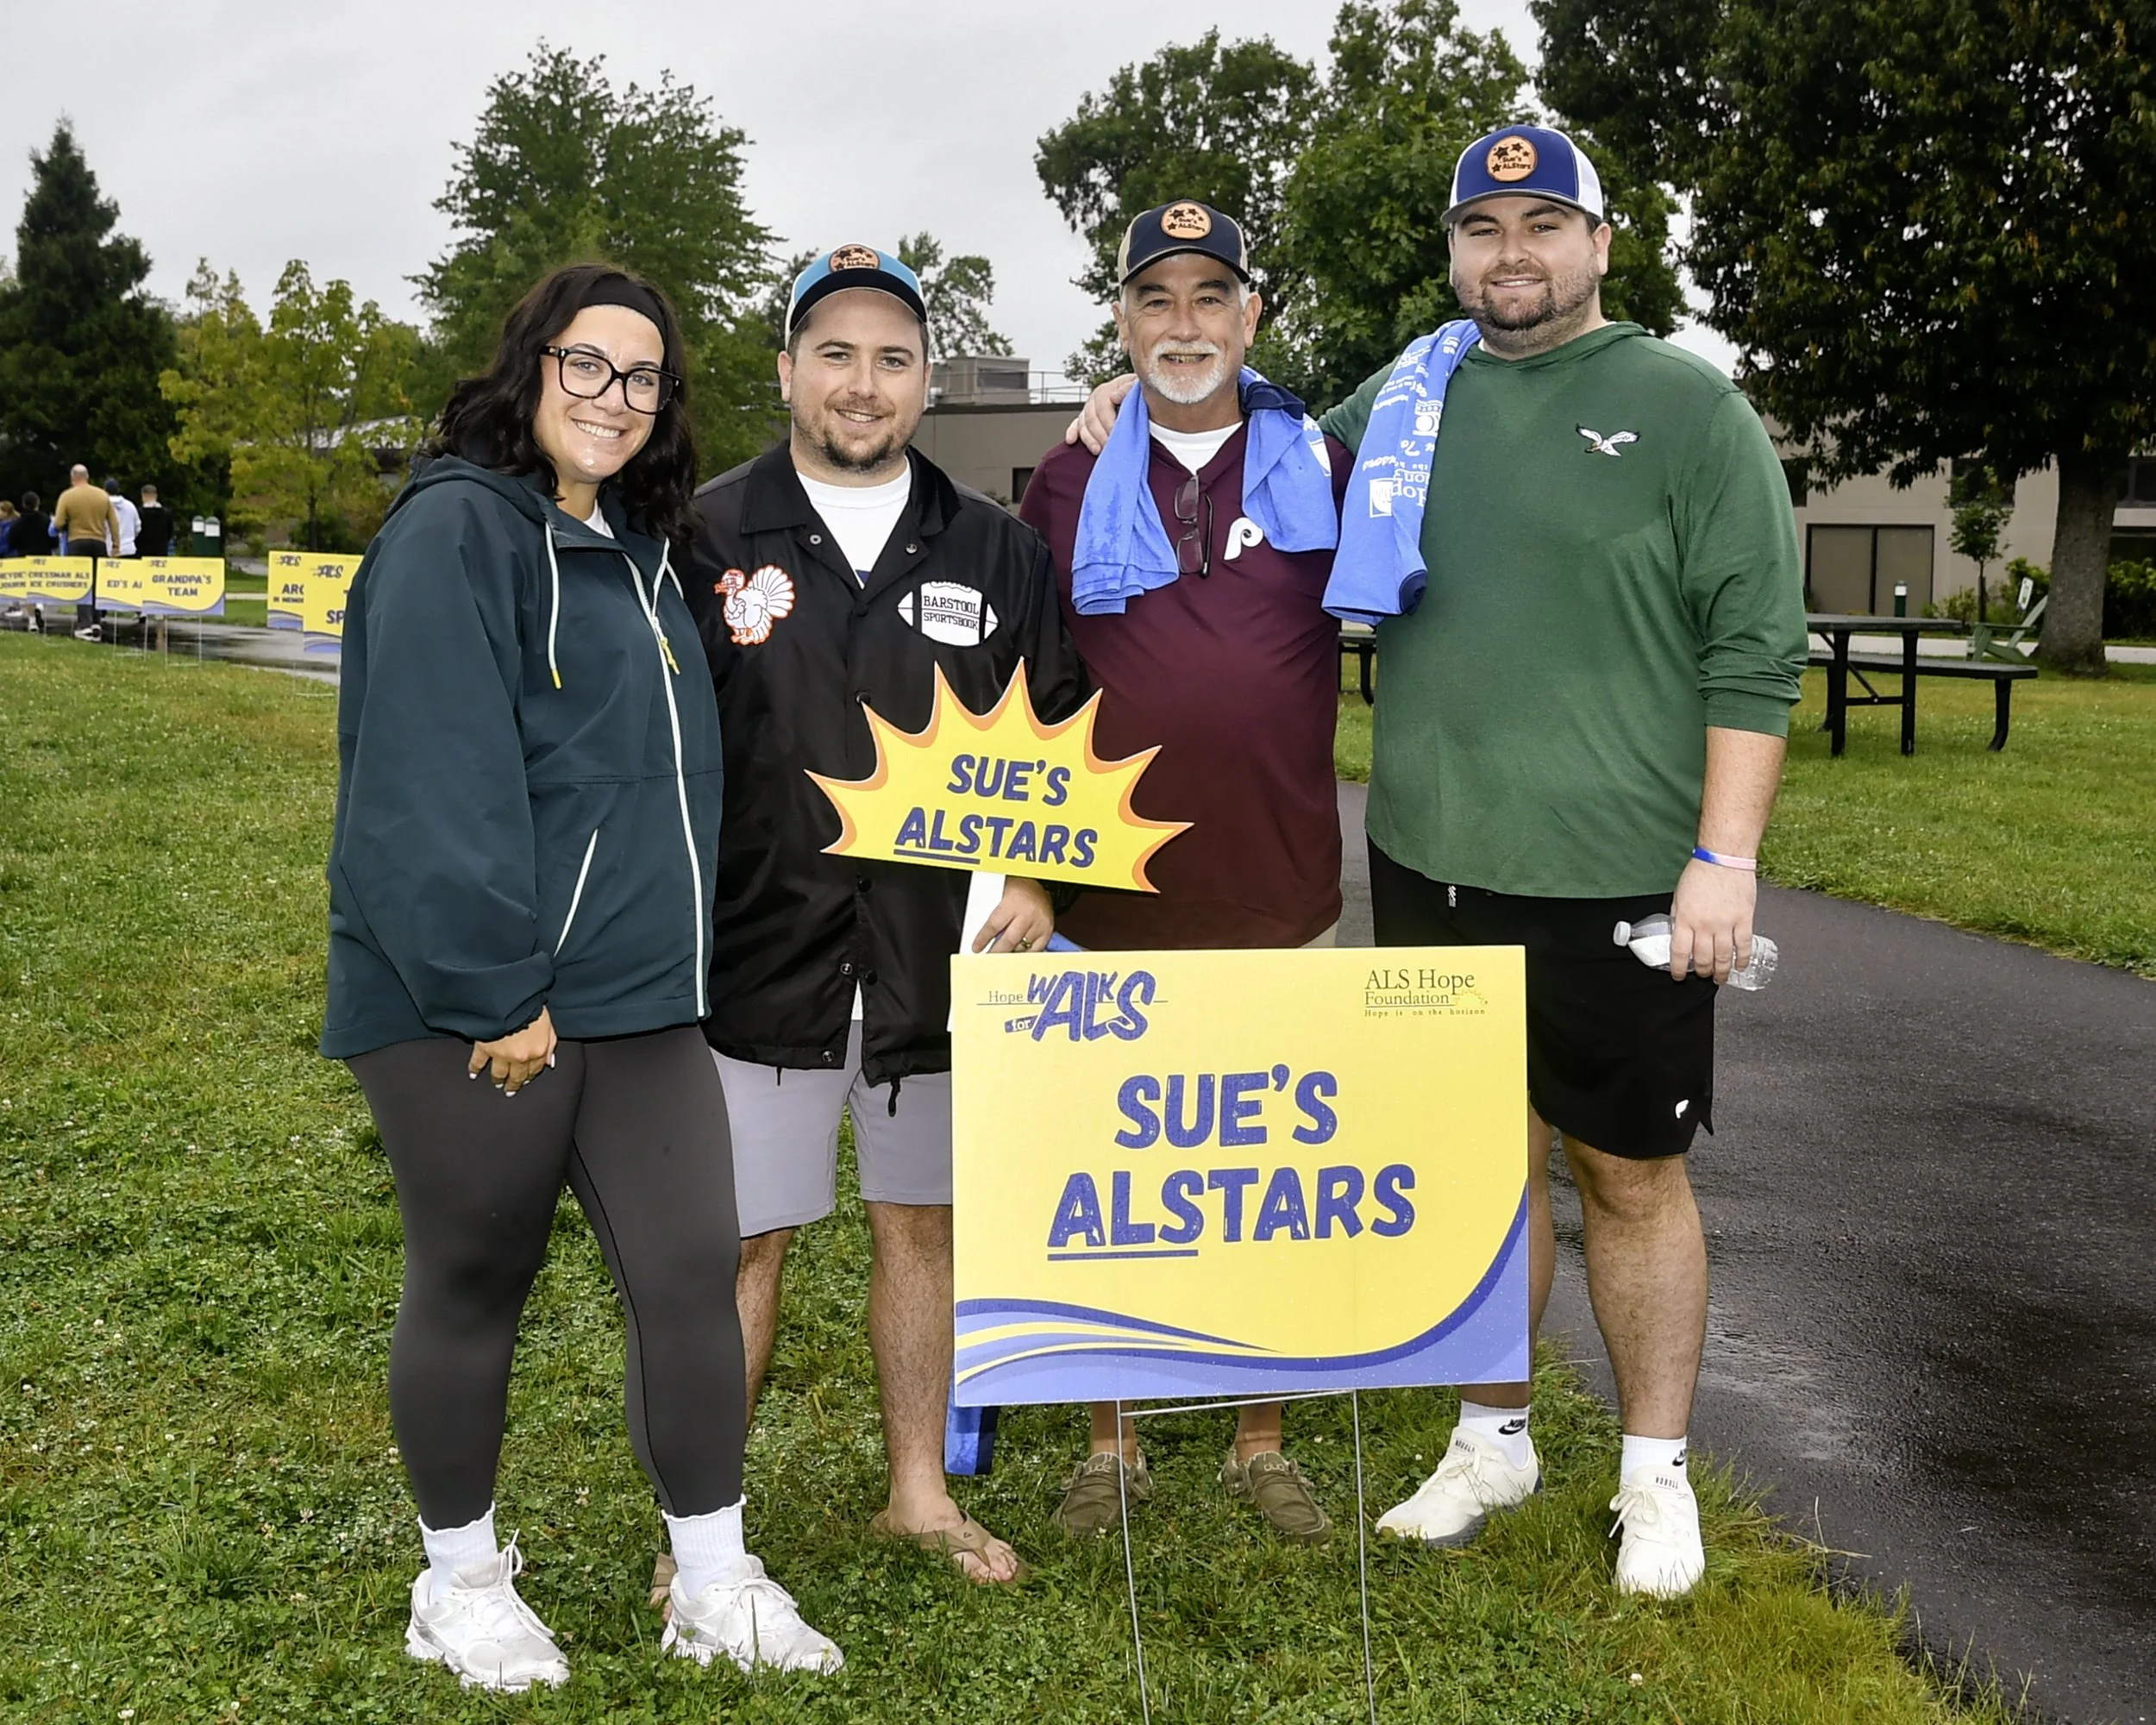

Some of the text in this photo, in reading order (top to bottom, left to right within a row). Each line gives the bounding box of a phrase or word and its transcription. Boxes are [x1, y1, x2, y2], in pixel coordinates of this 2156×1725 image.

[152, 574, 212, 585] GRANDPA'S
[167, 586, 198, 597] TEAM
[923, 595, 980, 616] BARSTOOL
[923, 612, 980, 631] SPORTSBOOK
[945, 753, 1071, 807] SUE'S
[893, 806, 1099, 869] ALSTARS
[1364, 968, 1476, 996] ALS Hope
[987, 990, 1024, 1005] Hope
[1364, 990, 1450, 1006] Foundation
[1364, 1010, 1388, 1019] Hope
[1011, 1019, 1031, 1032] for
[1113, 1063, 1338, 1150] SUE'S
[1046, 1164, 1416, 1247] ALSTARS
